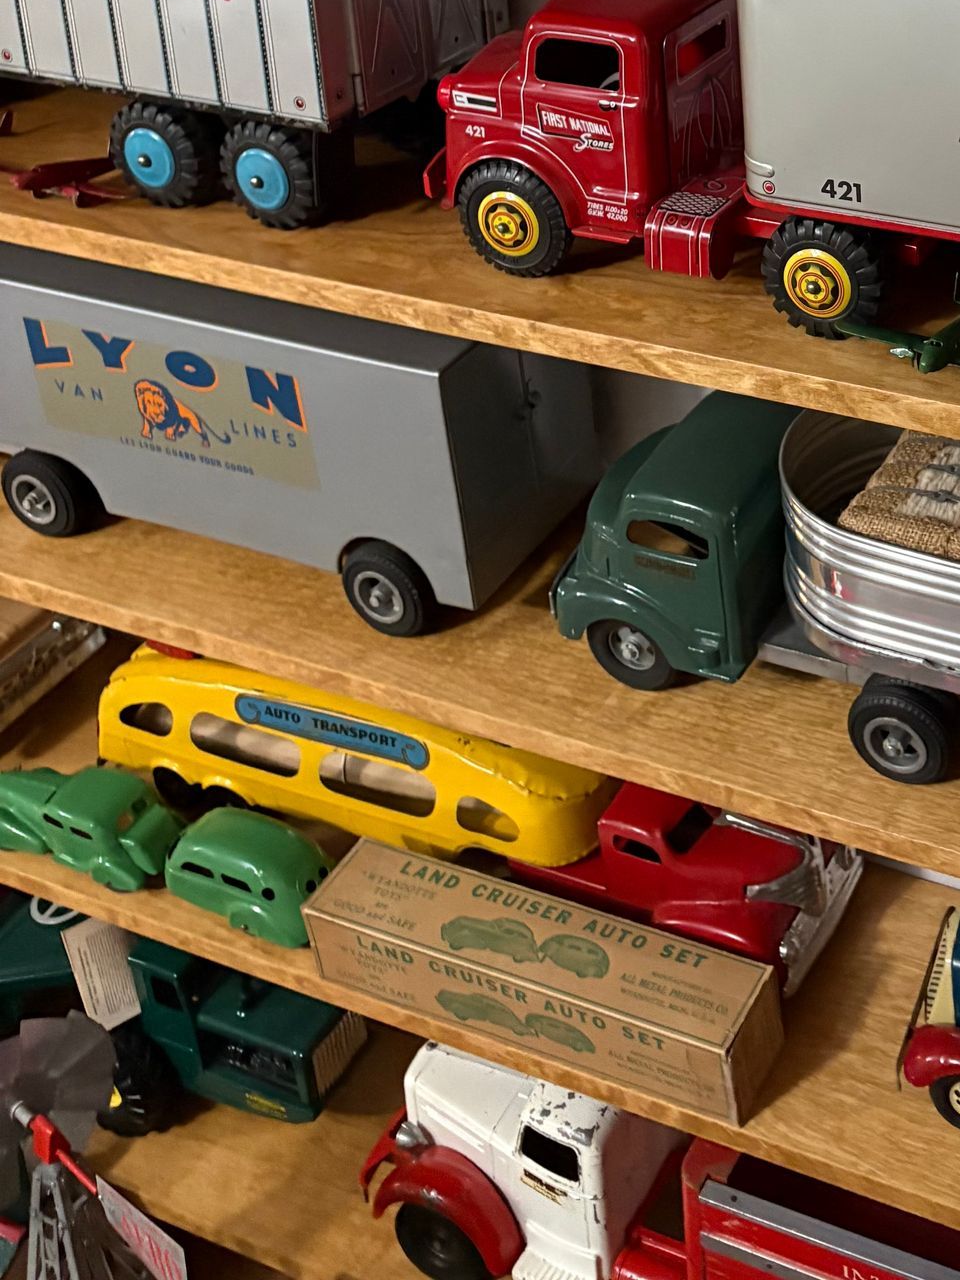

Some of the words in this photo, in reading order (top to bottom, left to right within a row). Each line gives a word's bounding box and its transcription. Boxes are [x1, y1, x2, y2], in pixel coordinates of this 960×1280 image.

[464, 124, 486, 138] 421
[541, 111, 568, 129] FIRST
[568, 118, 611, 137] NATIONAL
[821, 178, 862, 203] 421
[23, 317, 307, 432] LYON
[54, 378, 105, 402] VAN
[230, 418, 298, 448] LINES
[165, 446, 197, 462] GUARD
[198, 455, 223, 469] YOUR
[264, 705, 301, 724] AUTO
[311, 717, 398, 748] TRANSPORT
[399, 860, 461, 890] LAND
[471, 883, 573, 926] CRUISER
[582, 918, 649, 950] AUTO
[658, 941, 709, 969] SET
[356, 935, 415, 965] LAND
[429, 960, 529, 1007] CRUISER
[543, 1001, 607, 1031] AUTO
[621, 1025, 666, 1051] SET
